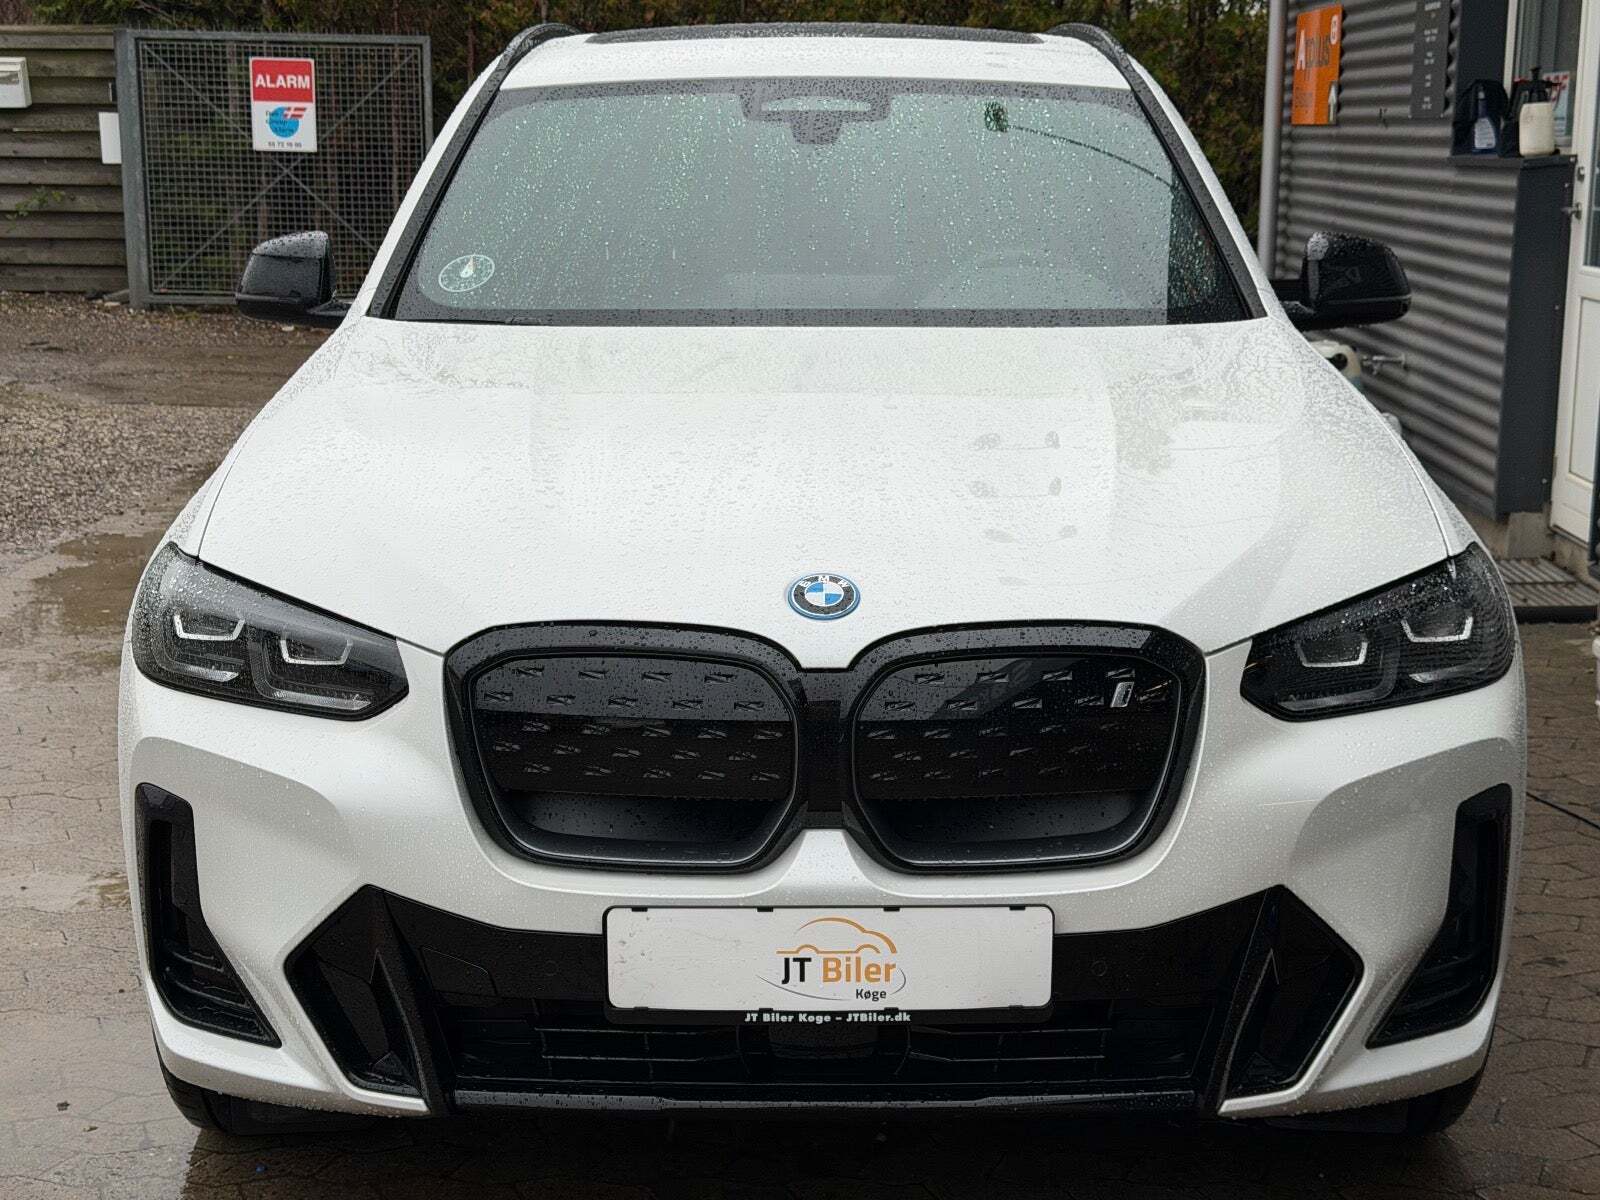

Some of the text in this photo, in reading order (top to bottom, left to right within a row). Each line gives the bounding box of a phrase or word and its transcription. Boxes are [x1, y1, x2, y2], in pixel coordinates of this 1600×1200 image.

[255, 73, 311, 89] ALARM
[799, 576, 851, 588] BMW
[781, 957, 896, 985] JT Biler
[855, 989, 887, 1002] Køge
[744, 1013, 759, 1022] JT
[762, 1012, 794, 1022] Biler
[846, 1012, 911, 1022] JTBiler.dk
